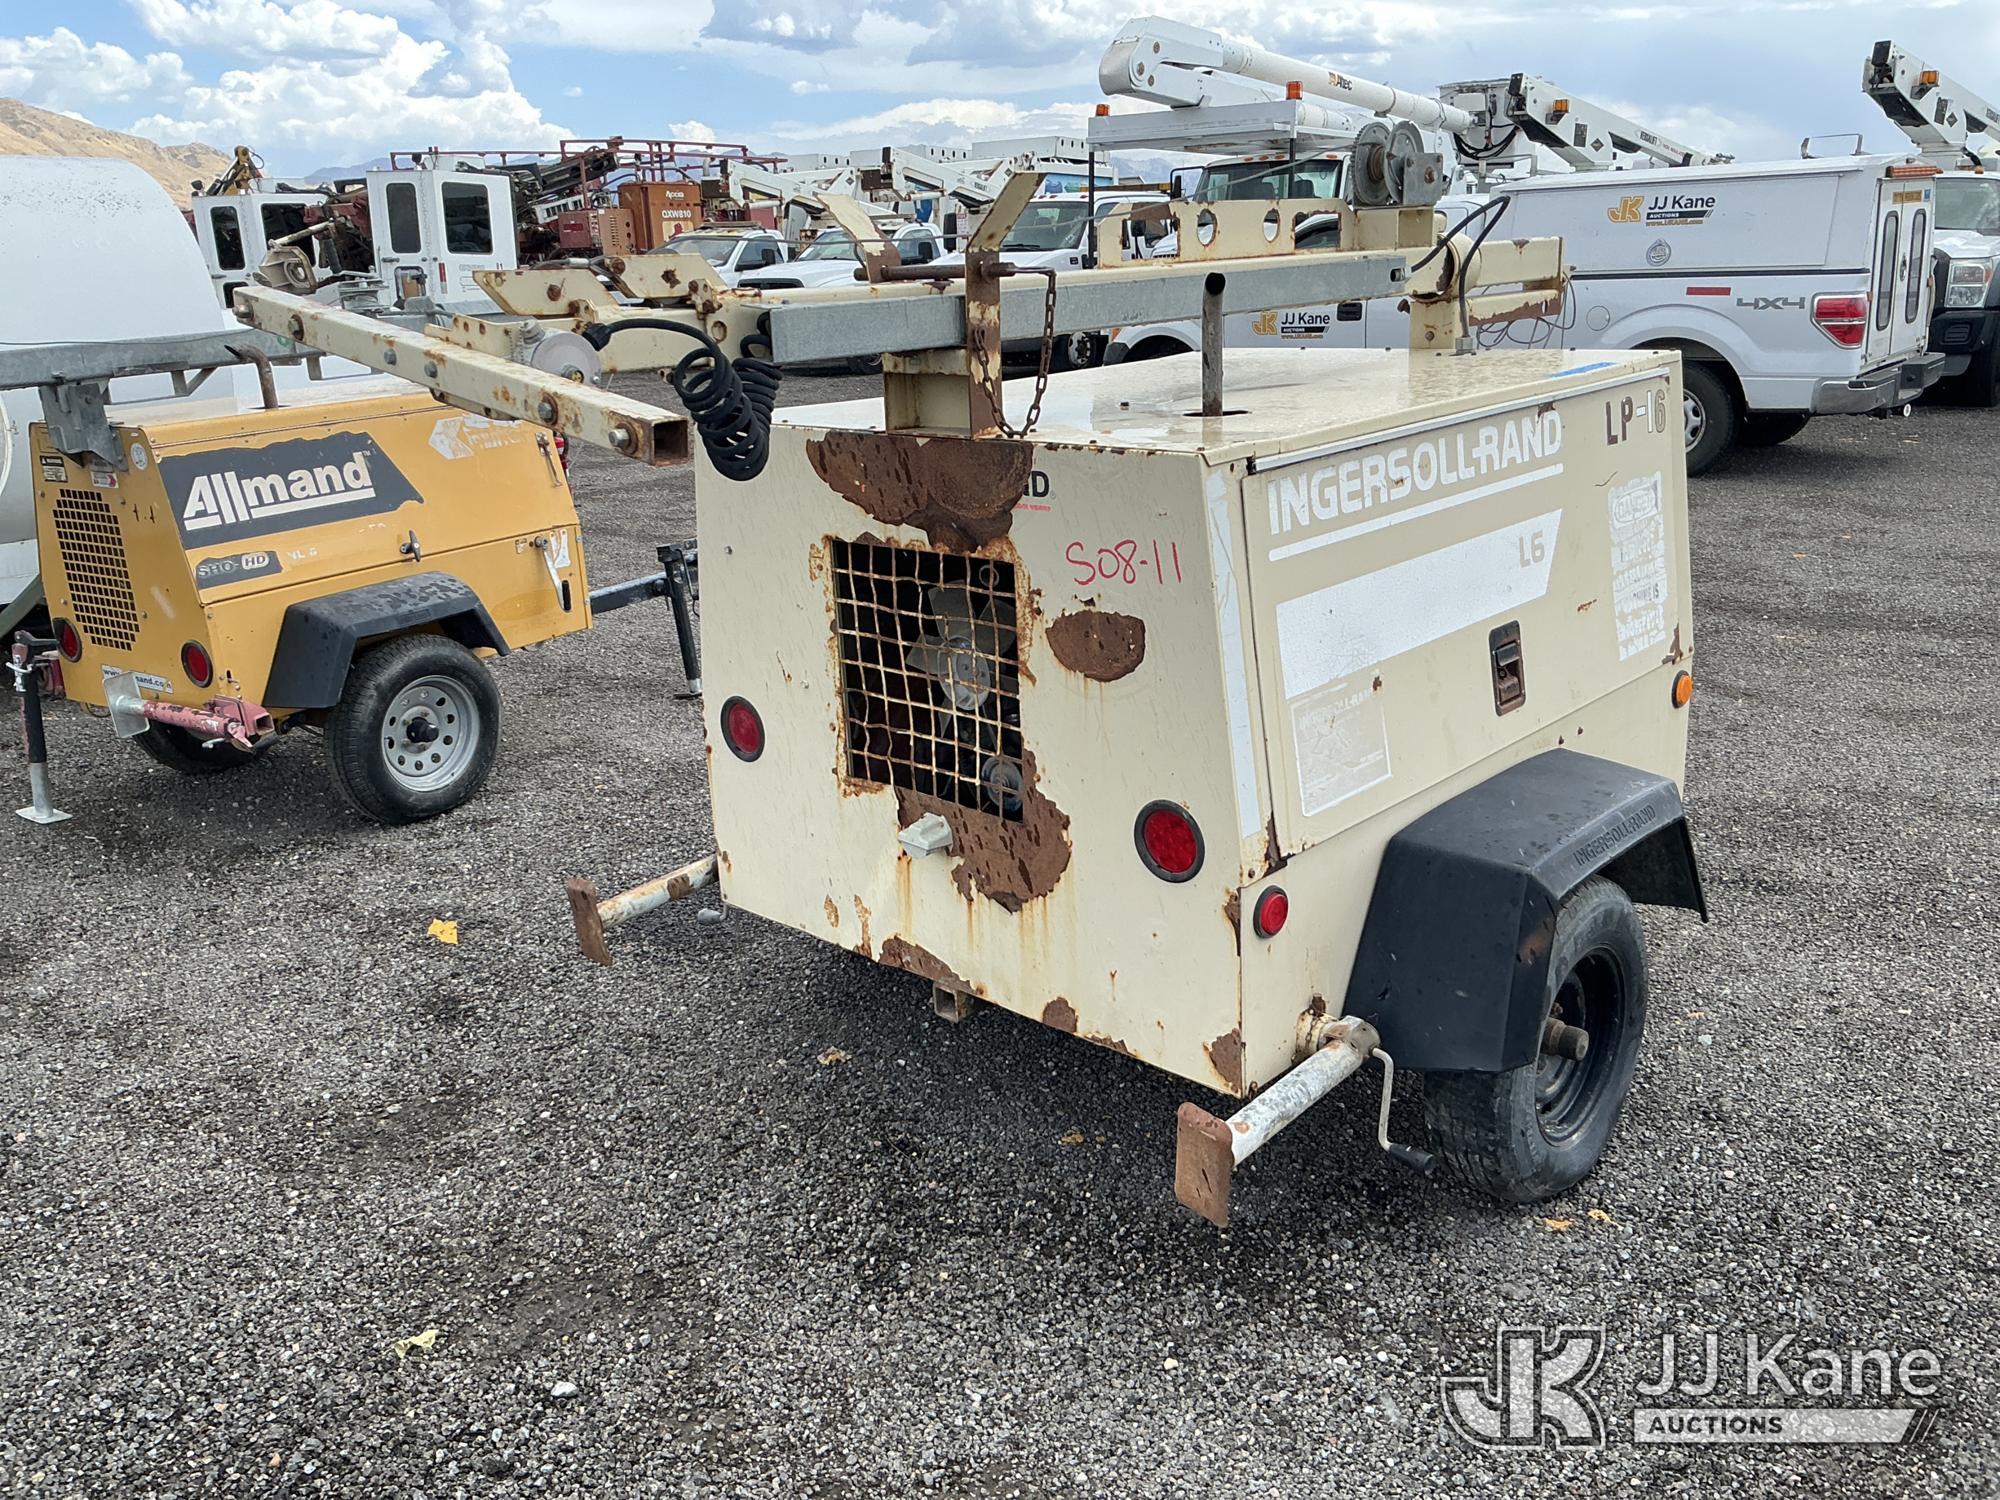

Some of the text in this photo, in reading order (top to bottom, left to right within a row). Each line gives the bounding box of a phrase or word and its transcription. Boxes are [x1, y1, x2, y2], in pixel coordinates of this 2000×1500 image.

[1648, 194, 1716, 211] JJ Kane
[1281, 311, 1331, 325] JJ Kane
[1605, 389, 1666, 446] LP-16
[183, 452, 372, 524] Allmand
[1267, 410, 1563, 535] INGERSOLL-RAND
[1066, 540, 1182, 586] S08-11
[1518, 530, 1545, 568] L6
